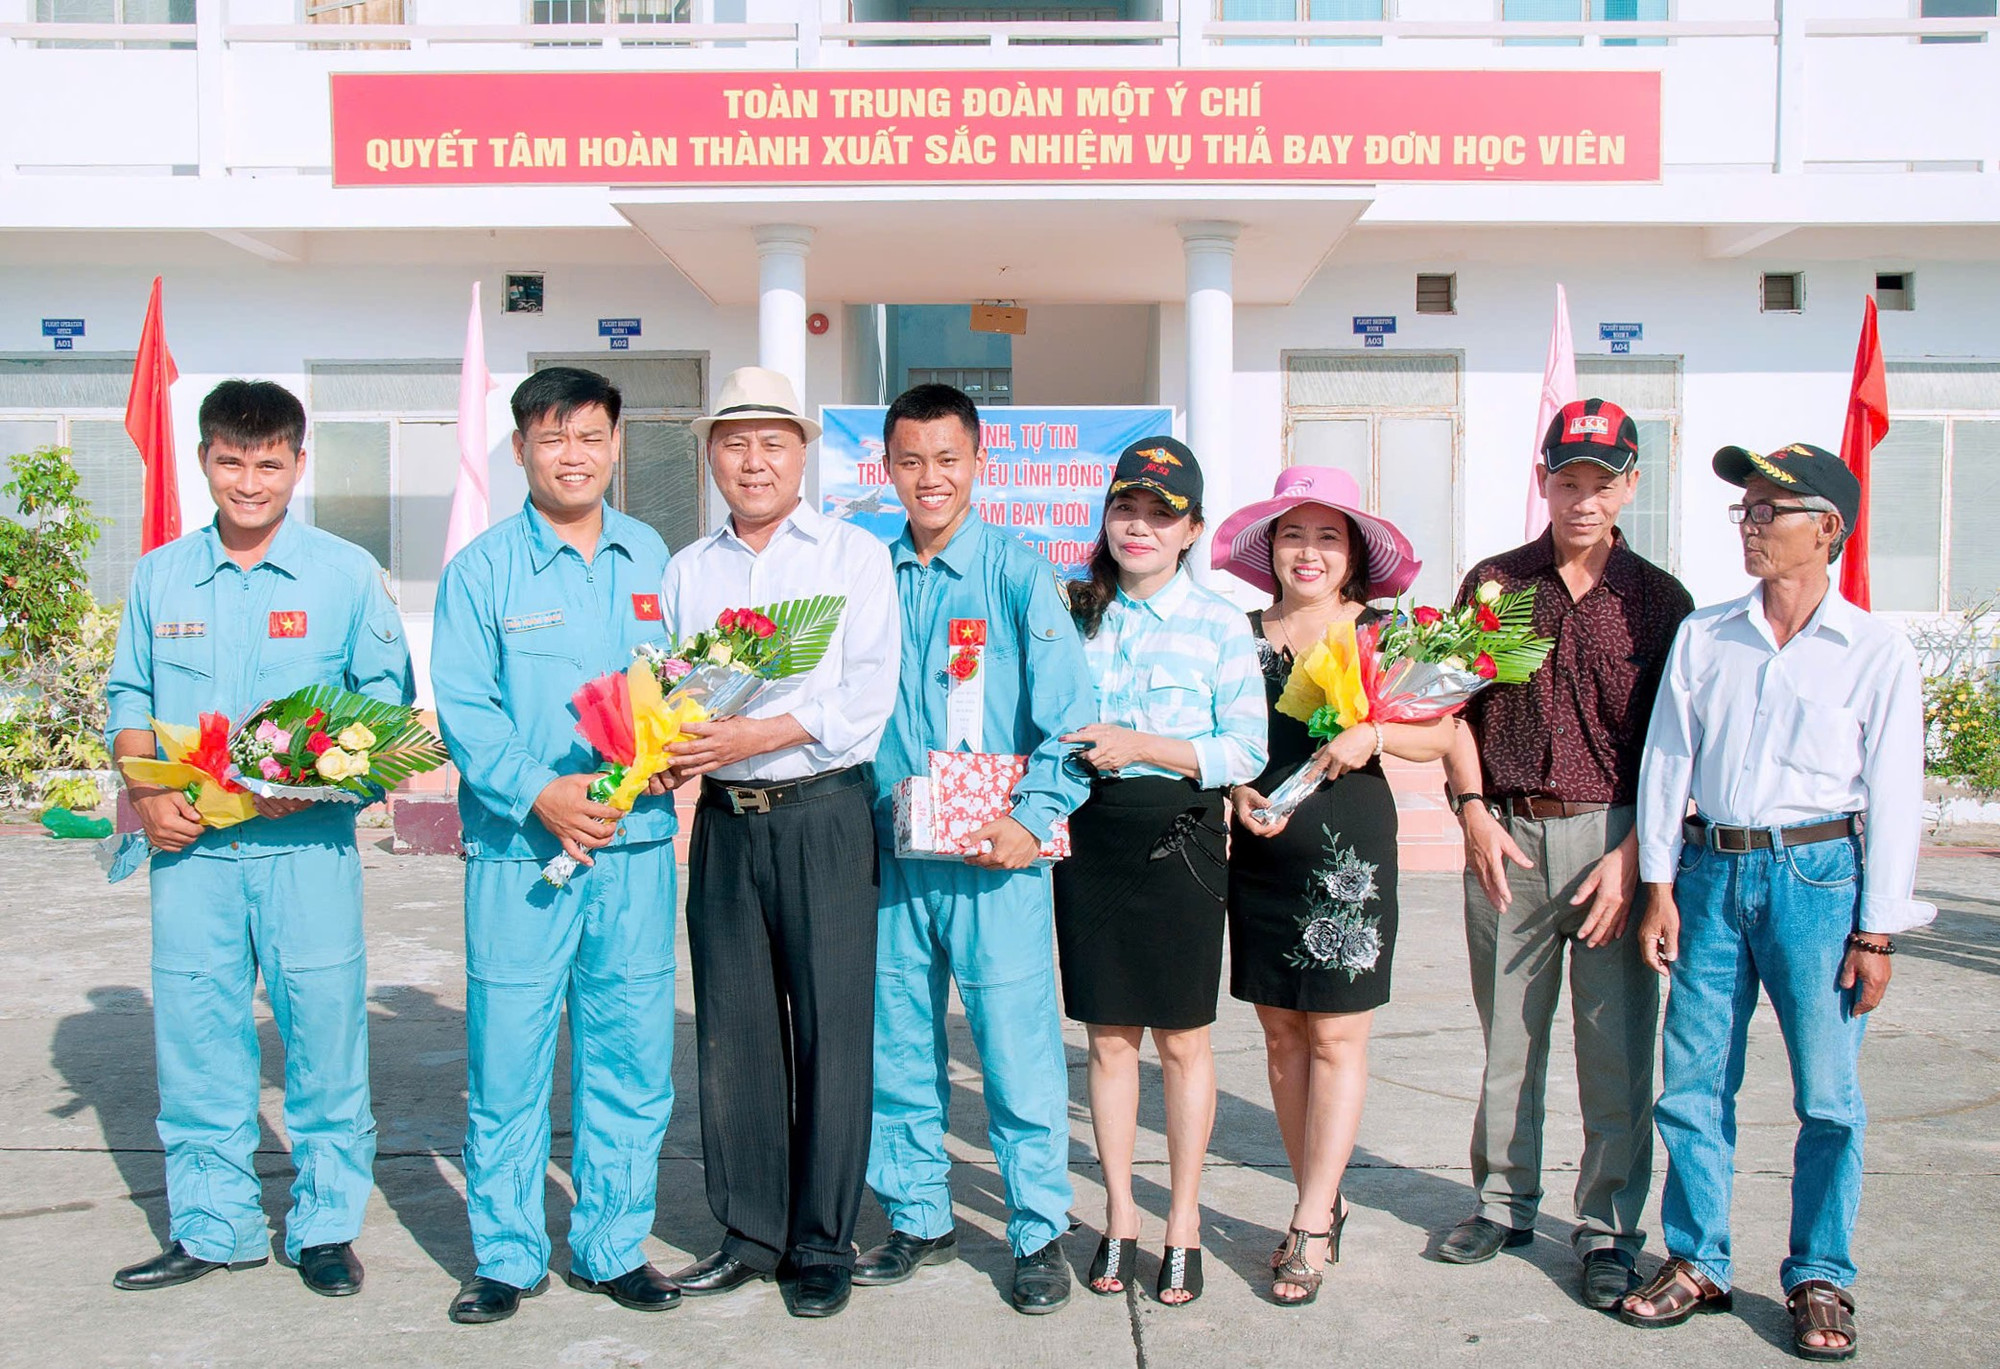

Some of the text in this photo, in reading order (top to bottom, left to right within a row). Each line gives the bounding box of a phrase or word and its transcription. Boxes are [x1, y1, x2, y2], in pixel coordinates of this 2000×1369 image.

[723, 80, 1262, 123] TOÀN TRUNG ĐOÀN MỘT Ý CHÍ
[366, 125, 1625, 171] QUYẾT TÂM HOÀN THÀNH XUẤT SẮC NHIỆM VỤ THẢ BAY ĐƠN HỌC VIÊN
[612, 339, 628, 347] A02
[1366, 337, 1382, 345] A03
[1612, 343, 1628, 351] A04
[1021, 422, 1046, 453] TỰ
[1049, 425, 1078, 448] TIN
[857, 463, 894, 485] TRU
[1014, 460, 1051, 486] LĨNH
[1057, 459, 1103, 492] ĐỘNG
[972, 497, 1090, 526] ÂM BAY ĐƠN
